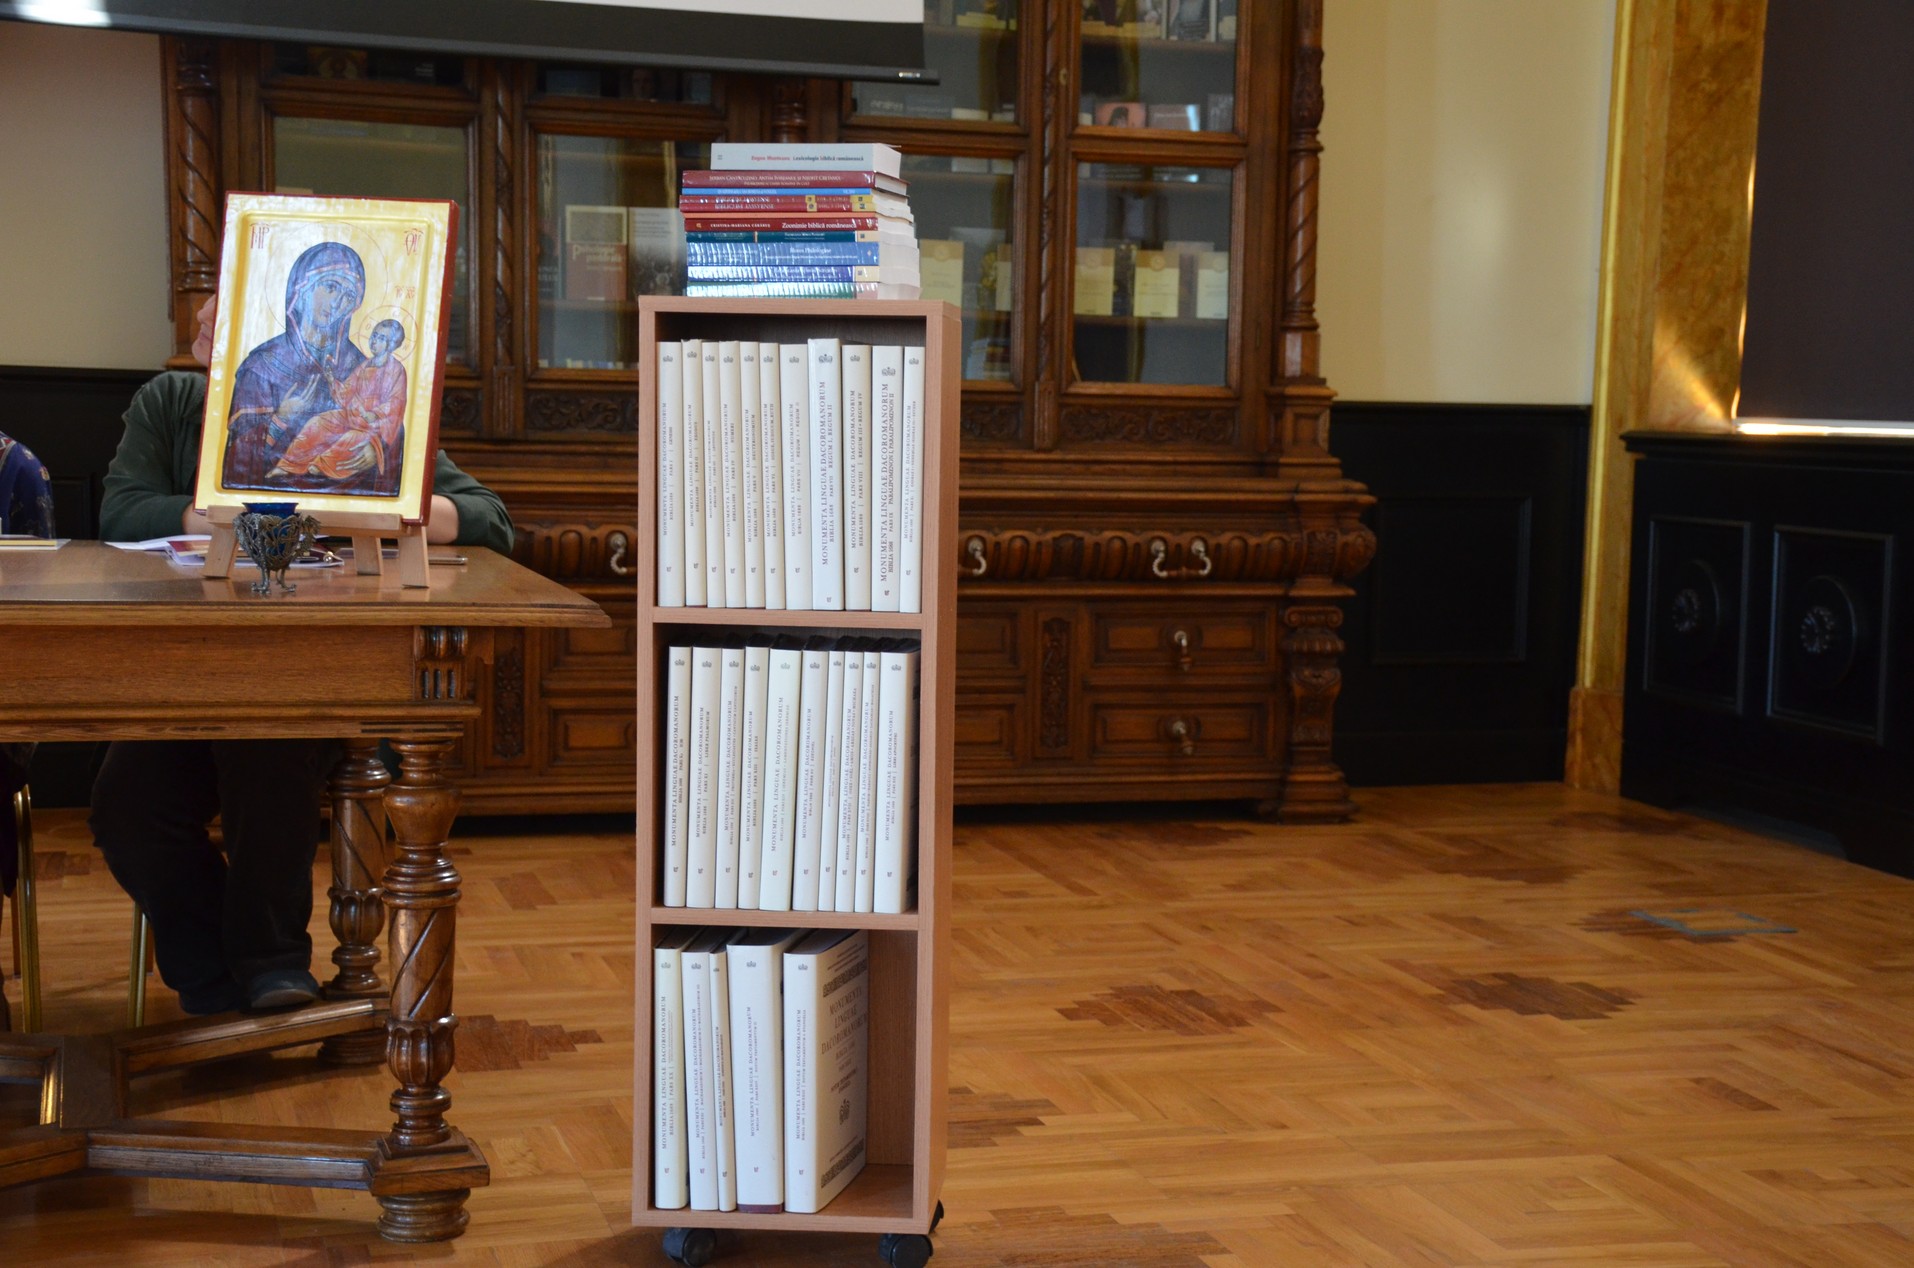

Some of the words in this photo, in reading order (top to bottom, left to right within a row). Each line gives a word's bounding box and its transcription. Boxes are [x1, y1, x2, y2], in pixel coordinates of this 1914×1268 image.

[819, 381, 827, 464] DACOROMANORUM
[880, 519, 888, 582] MONUMENTA
[771, 804, 779, 852] MONUMENTA
[775, 697, 784, 765] DACOROMANORUM
